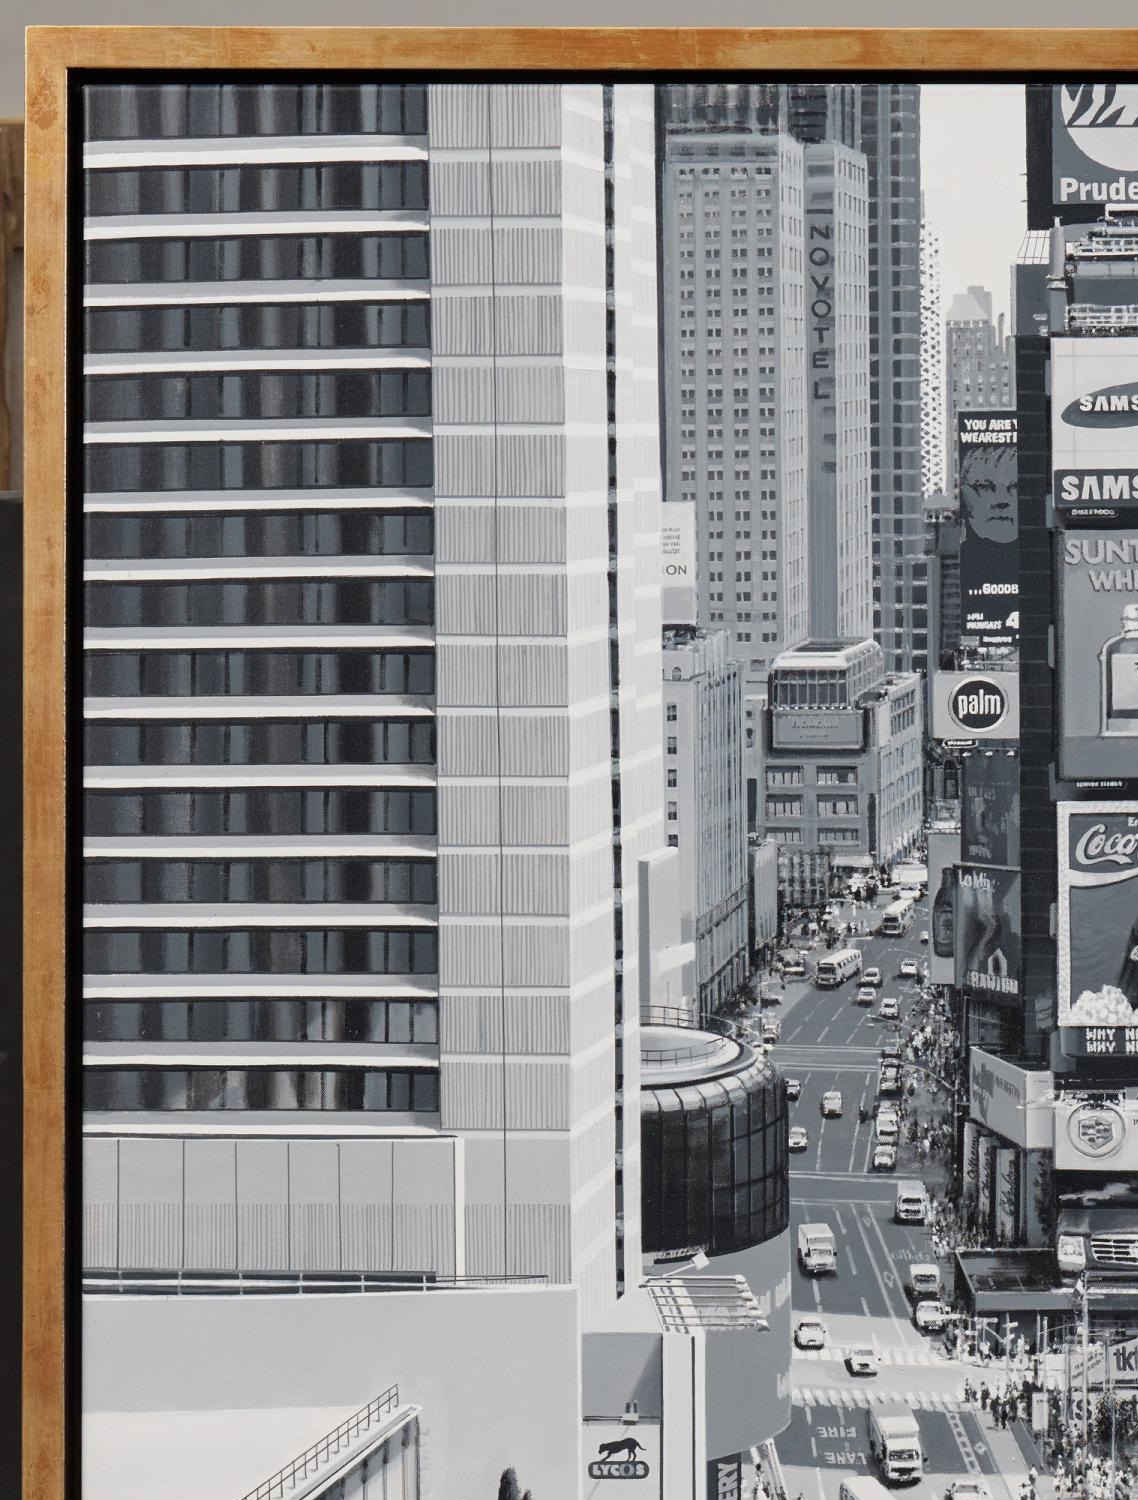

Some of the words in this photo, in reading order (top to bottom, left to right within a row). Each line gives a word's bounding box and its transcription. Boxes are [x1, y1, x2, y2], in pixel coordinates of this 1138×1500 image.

[808, 224, 832, 400] NOVOTEL
[964, 419, 987, 431] YOU
[988, 419, 1011, 431] ARE
[1005, 611, 1020, 629] 4
[957, 689, 1001, 719] palm
[1086, 1027, 1116, 1041] WHY
[1086, 1041, 1116, 1054] WHY
[824, 1451, 868, 1465] LANE
[592, 1463, 645, 1477] LYCOS
